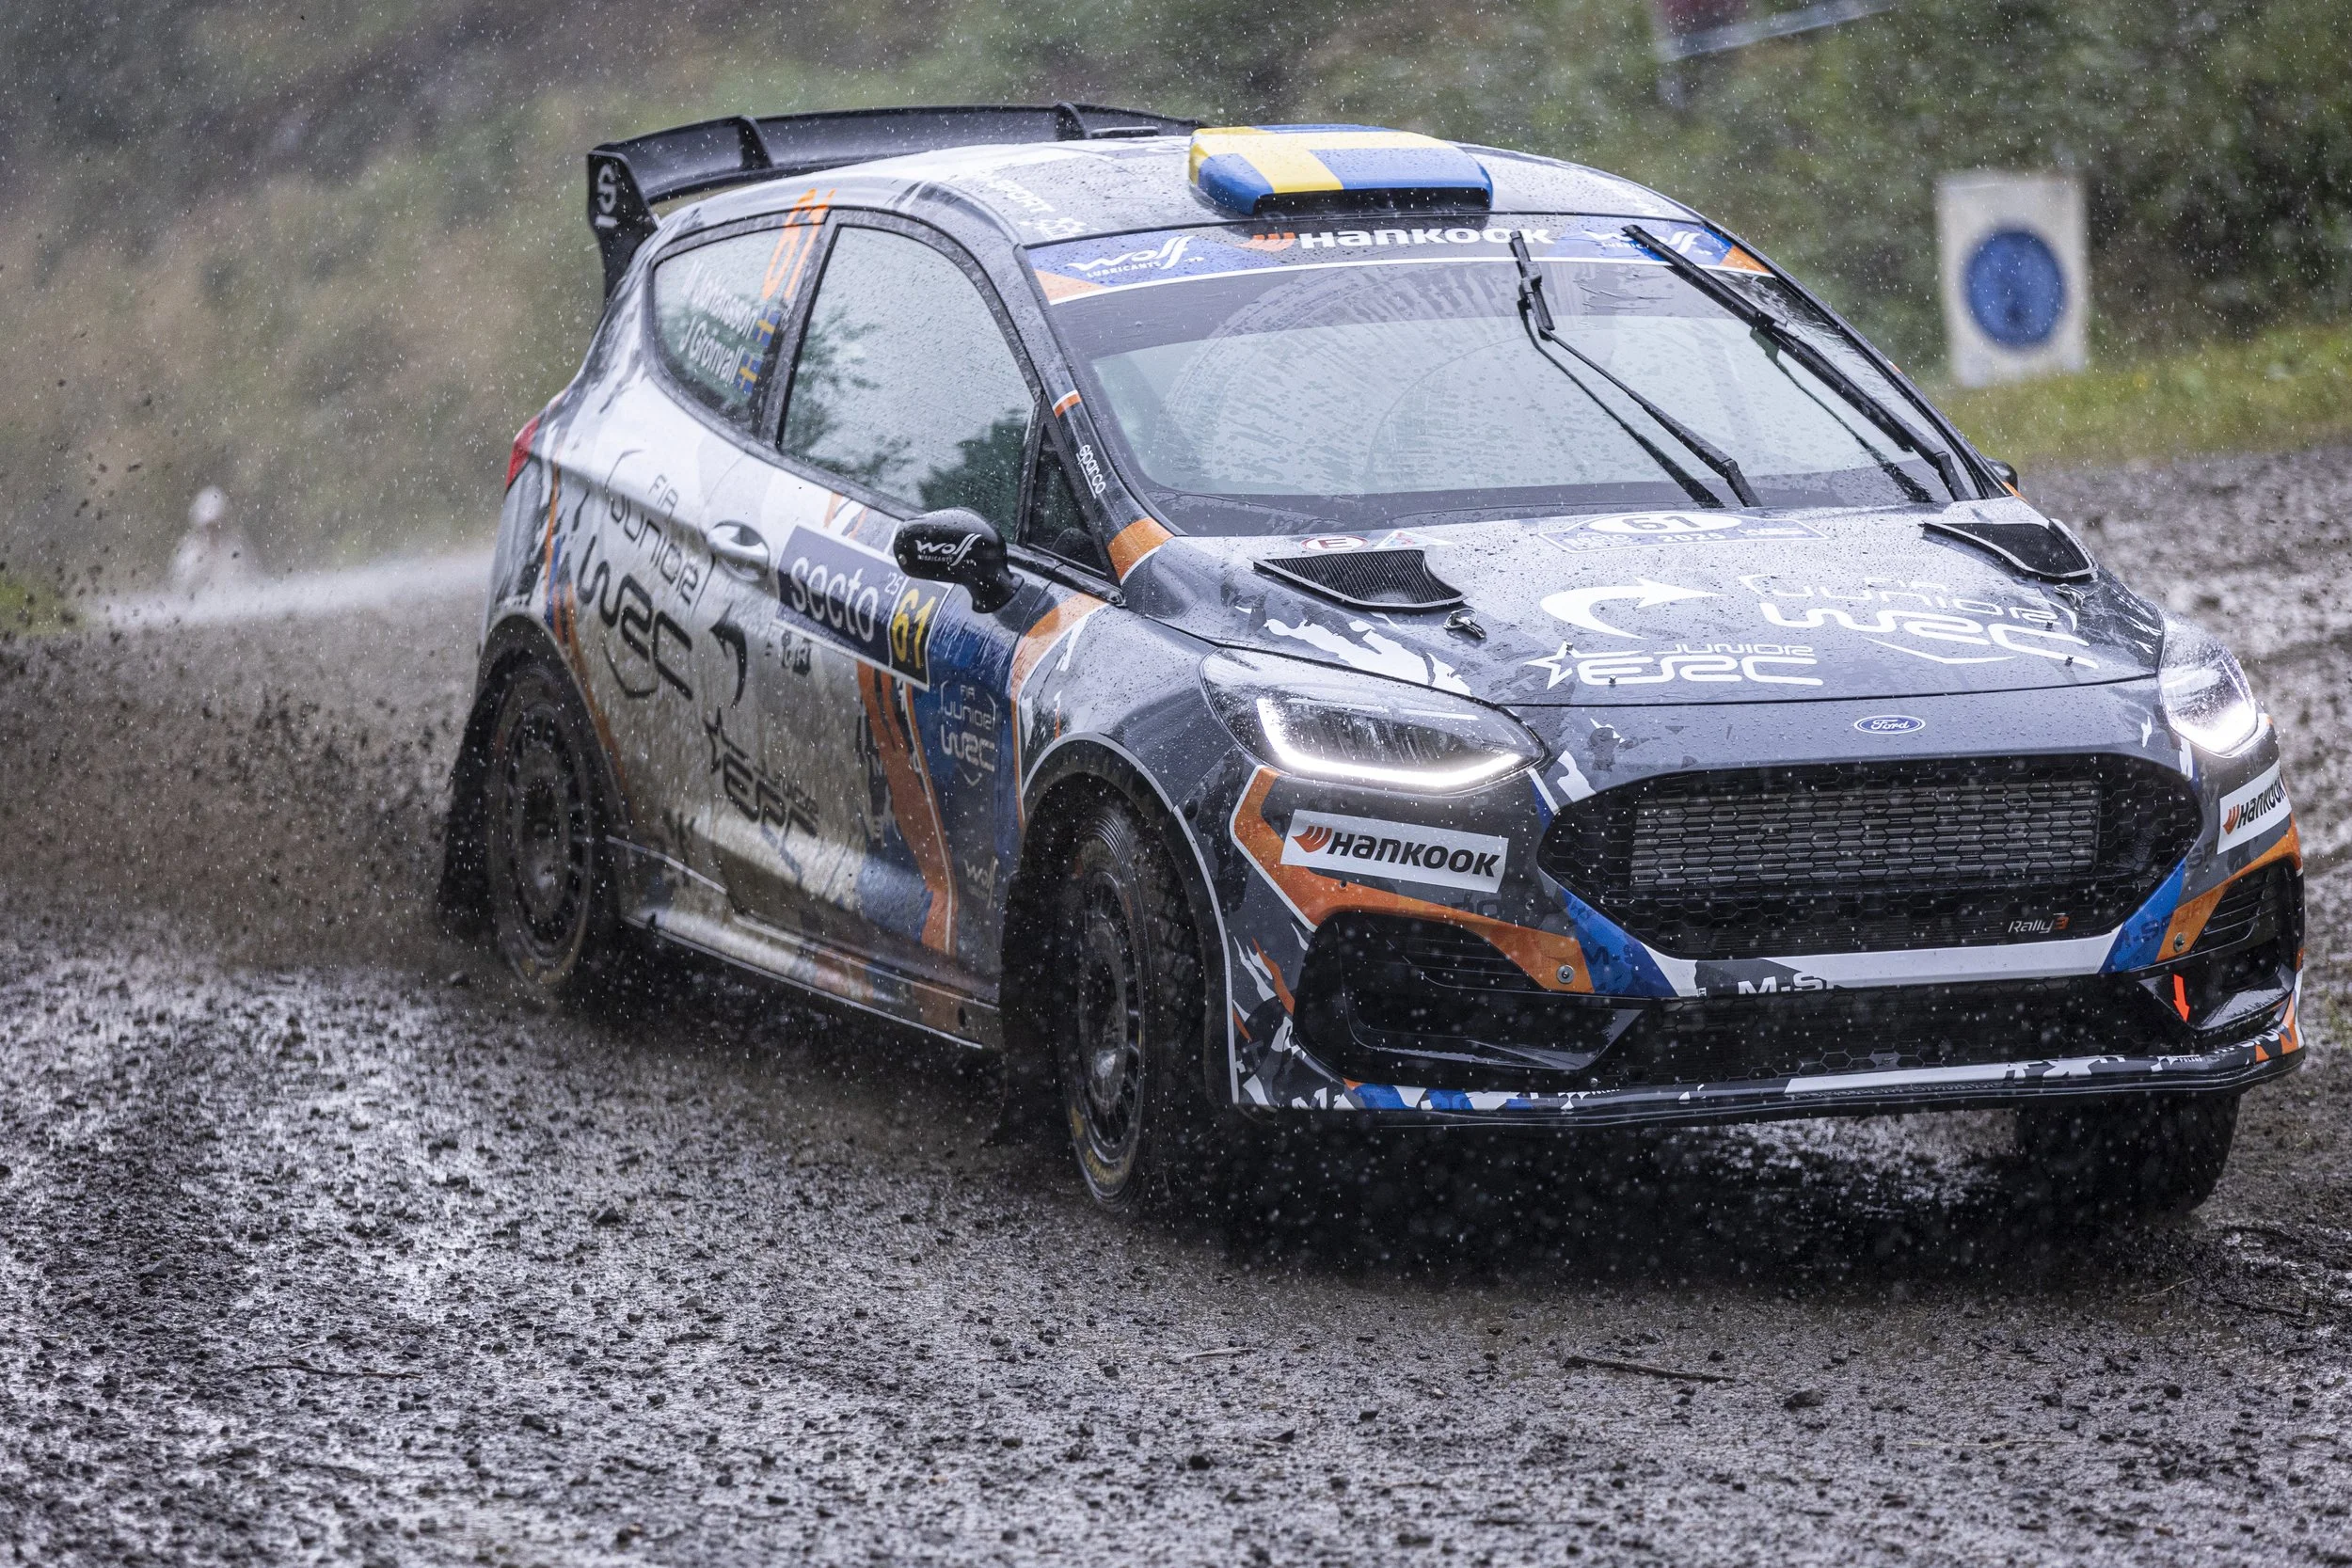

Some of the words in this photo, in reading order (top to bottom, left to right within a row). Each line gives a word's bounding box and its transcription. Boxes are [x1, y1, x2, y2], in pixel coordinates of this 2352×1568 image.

[1087, 262, 1163, 278] LUBRICANTS
[1078, 444, 1107, 496] sparco
[1621, 515, 1702, 531] 61
[1318, 538, 1354, 548] E
[1658, 531, 1726, 543] 2025
[790, 556, 880, 643] secto
[892, 588, 937, 671] 61
[1758, 602, 2100, 669] WRC
[1652, 643, 1816, 657] JUNIOR
[1579, 651, 1823, 686] ERC
[1870, 719, 1910, 730] Ford
